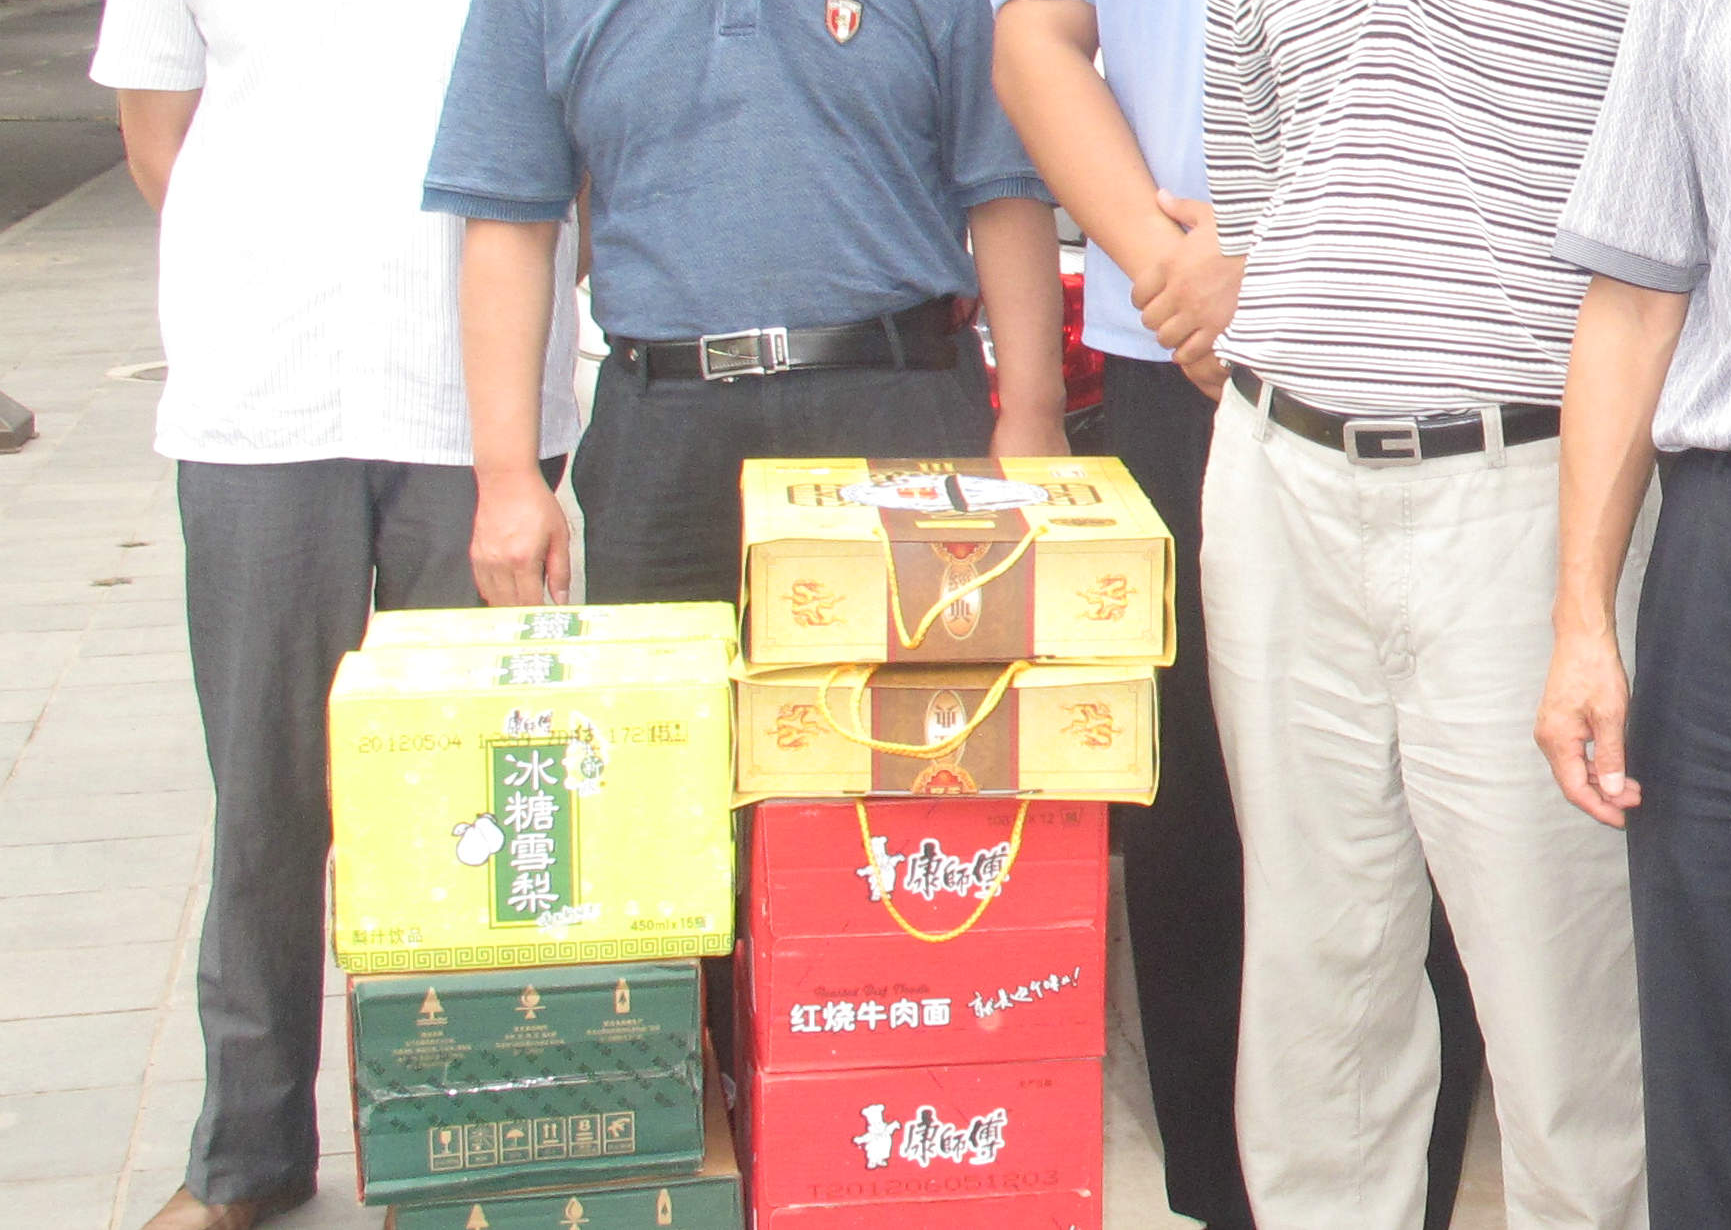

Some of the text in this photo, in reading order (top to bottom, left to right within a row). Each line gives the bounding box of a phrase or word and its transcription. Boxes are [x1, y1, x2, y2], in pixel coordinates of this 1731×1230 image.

[503, 749, 559, 914] 冰糖雪梨
[905, 839, 1010, 898] 康師傅
[352, 927, 423, 946] 梨汁饮品
[789, 998, 951, 1032] 红烧牛肉面
[903, 1107, 1006, 1165] 康師傅
